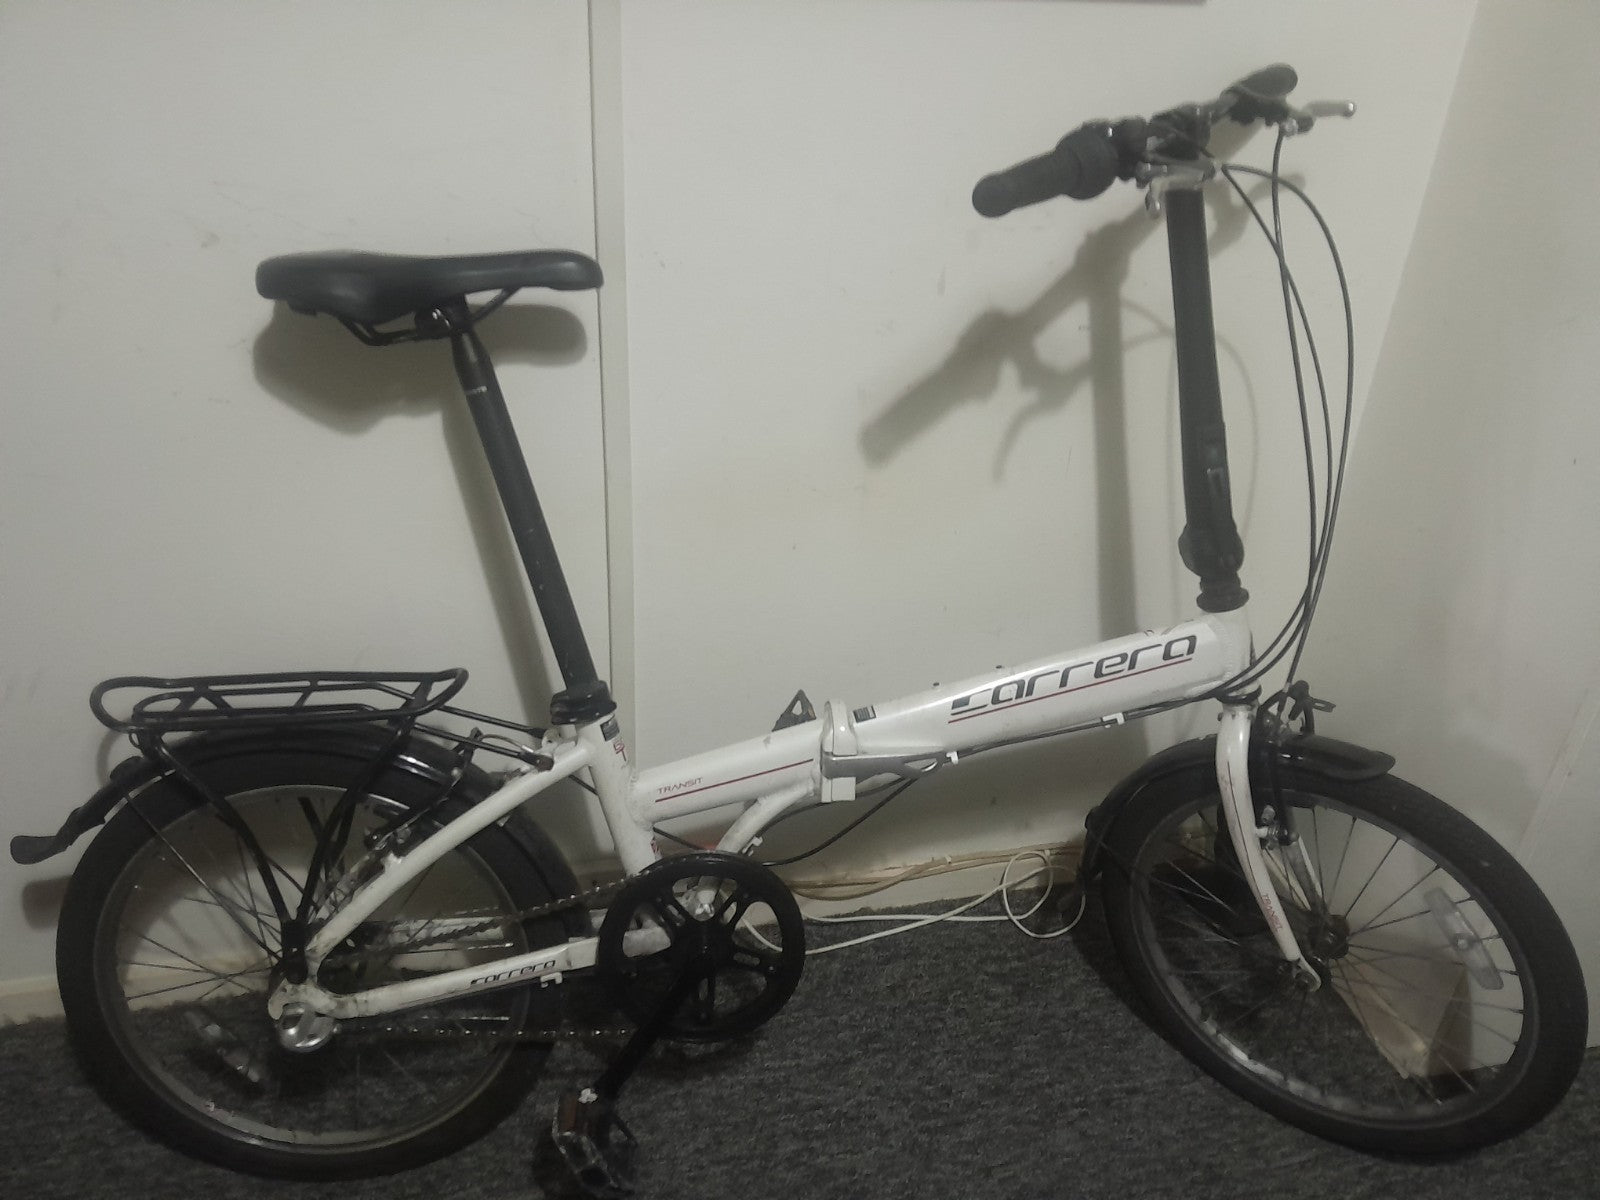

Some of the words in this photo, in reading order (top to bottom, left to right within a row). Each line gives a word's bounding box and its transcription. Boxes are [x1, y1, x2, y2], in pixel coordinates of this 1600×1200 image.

[951, 635, 1197, 716] carrera
[657, 776, 703, 795] TRANSIT
[470, 960, 556, 985] carrera
